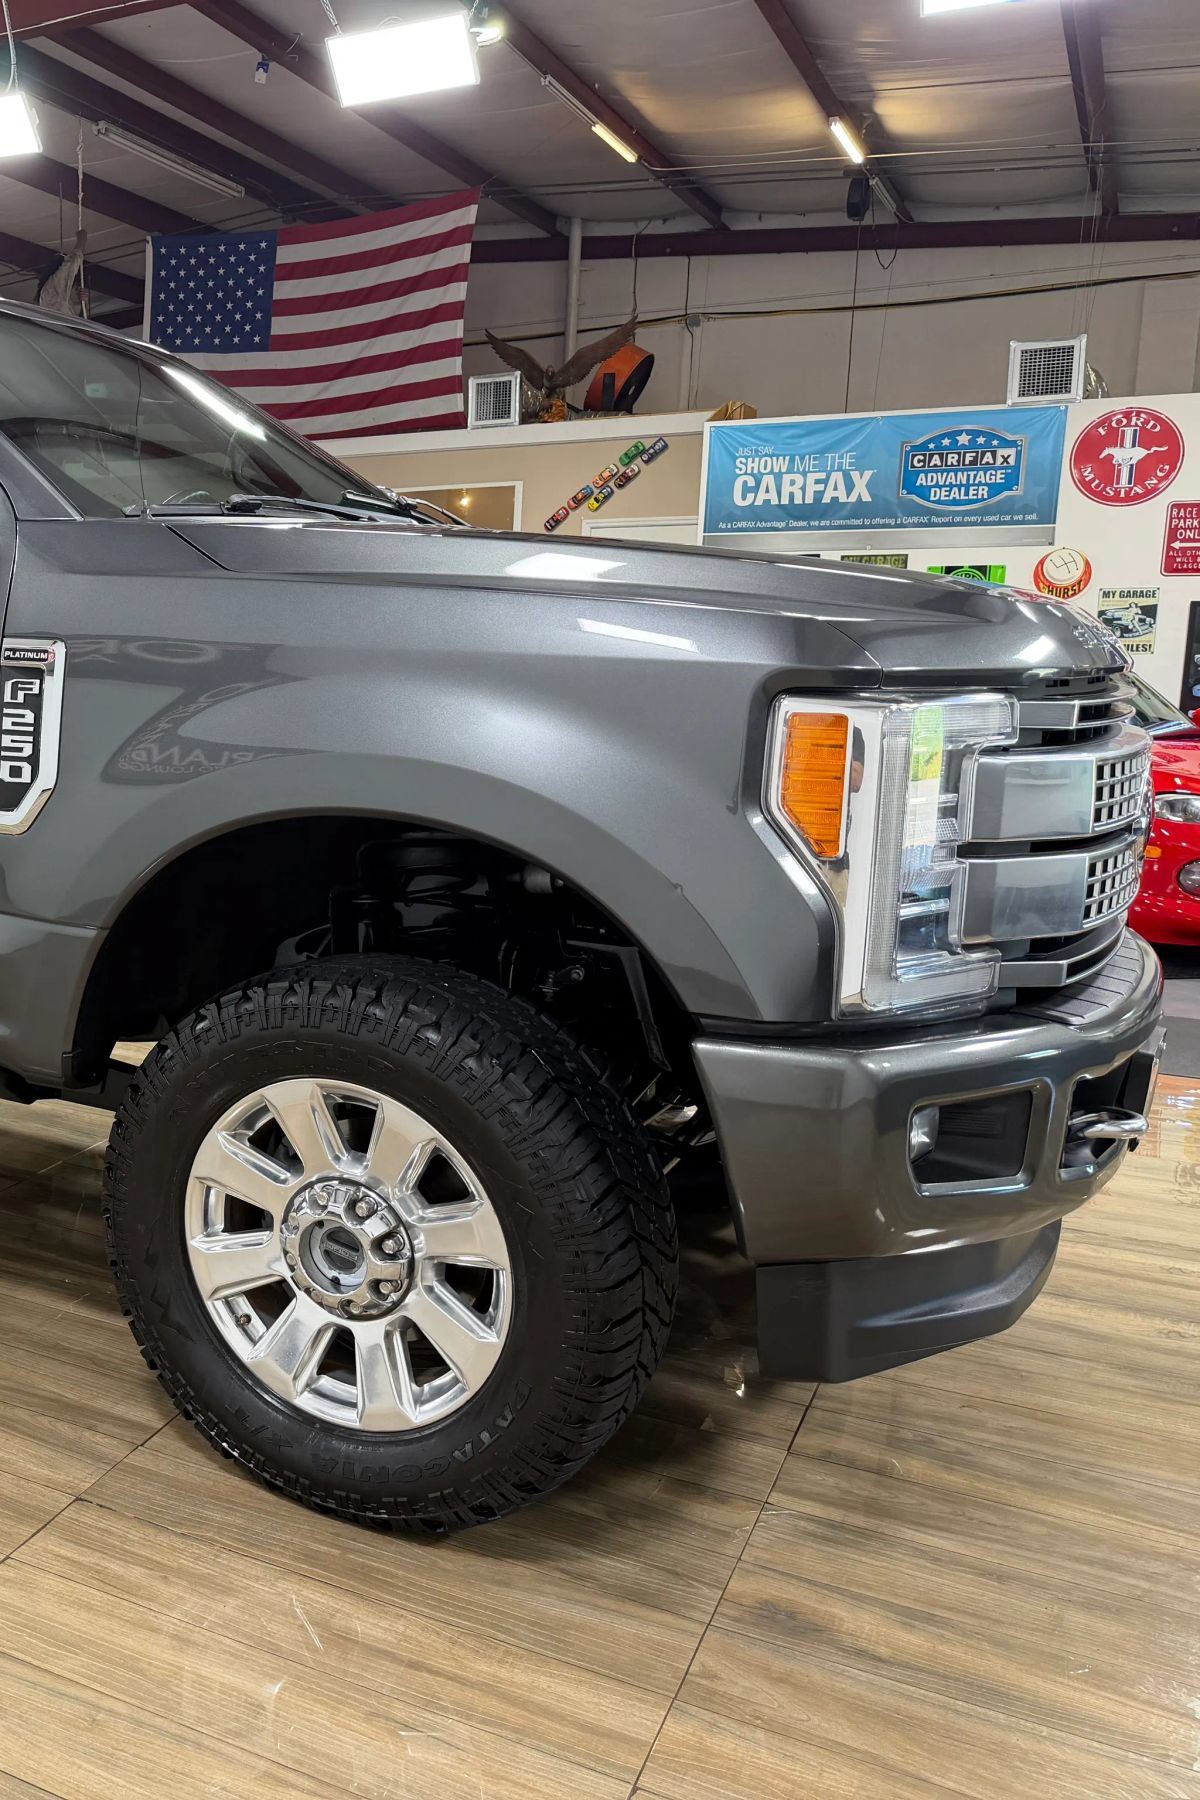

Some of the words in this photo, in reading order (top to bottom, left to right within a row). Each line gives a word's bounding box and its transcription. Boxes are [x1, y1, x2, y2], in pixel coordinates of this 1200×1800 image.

[1097, 414, 1160, 436] FORD
[736, 447, 756, 456] JUST
[758, 446, 774, 455] SAY
[735, 456, 790, 474] SHOW
[794, 454, 820, 473] ME
[824, 452, 857, 471] THE
[912, 452, 1012, 468] CARFAX
[916, 470, 1006, 487] ADVANTAGE
[1080, 463, 1170, 498] MUSTANG
[733, 470, 874, 507] CARFAX
[930, 486, 988, 501] DEALER
[1171, 507, 1199, 518] RACE
[732, 520, 755, 529] CARFAX
[831, 519, 863, 527] committed
[871, 517, 895, 526] offering
[931, 515, 953, 525] Report
[964, 515, 981, 524] every
[983, 514, 999, 522] used
[1000, 514, 1011, 522] car
[1047, 579, 1083, 599] HURST
[1102, 590, 1116, 599] MY
[1118, 589, 1157, 599] GARAGE
[4, 649, 49, 660] PLATINUM
